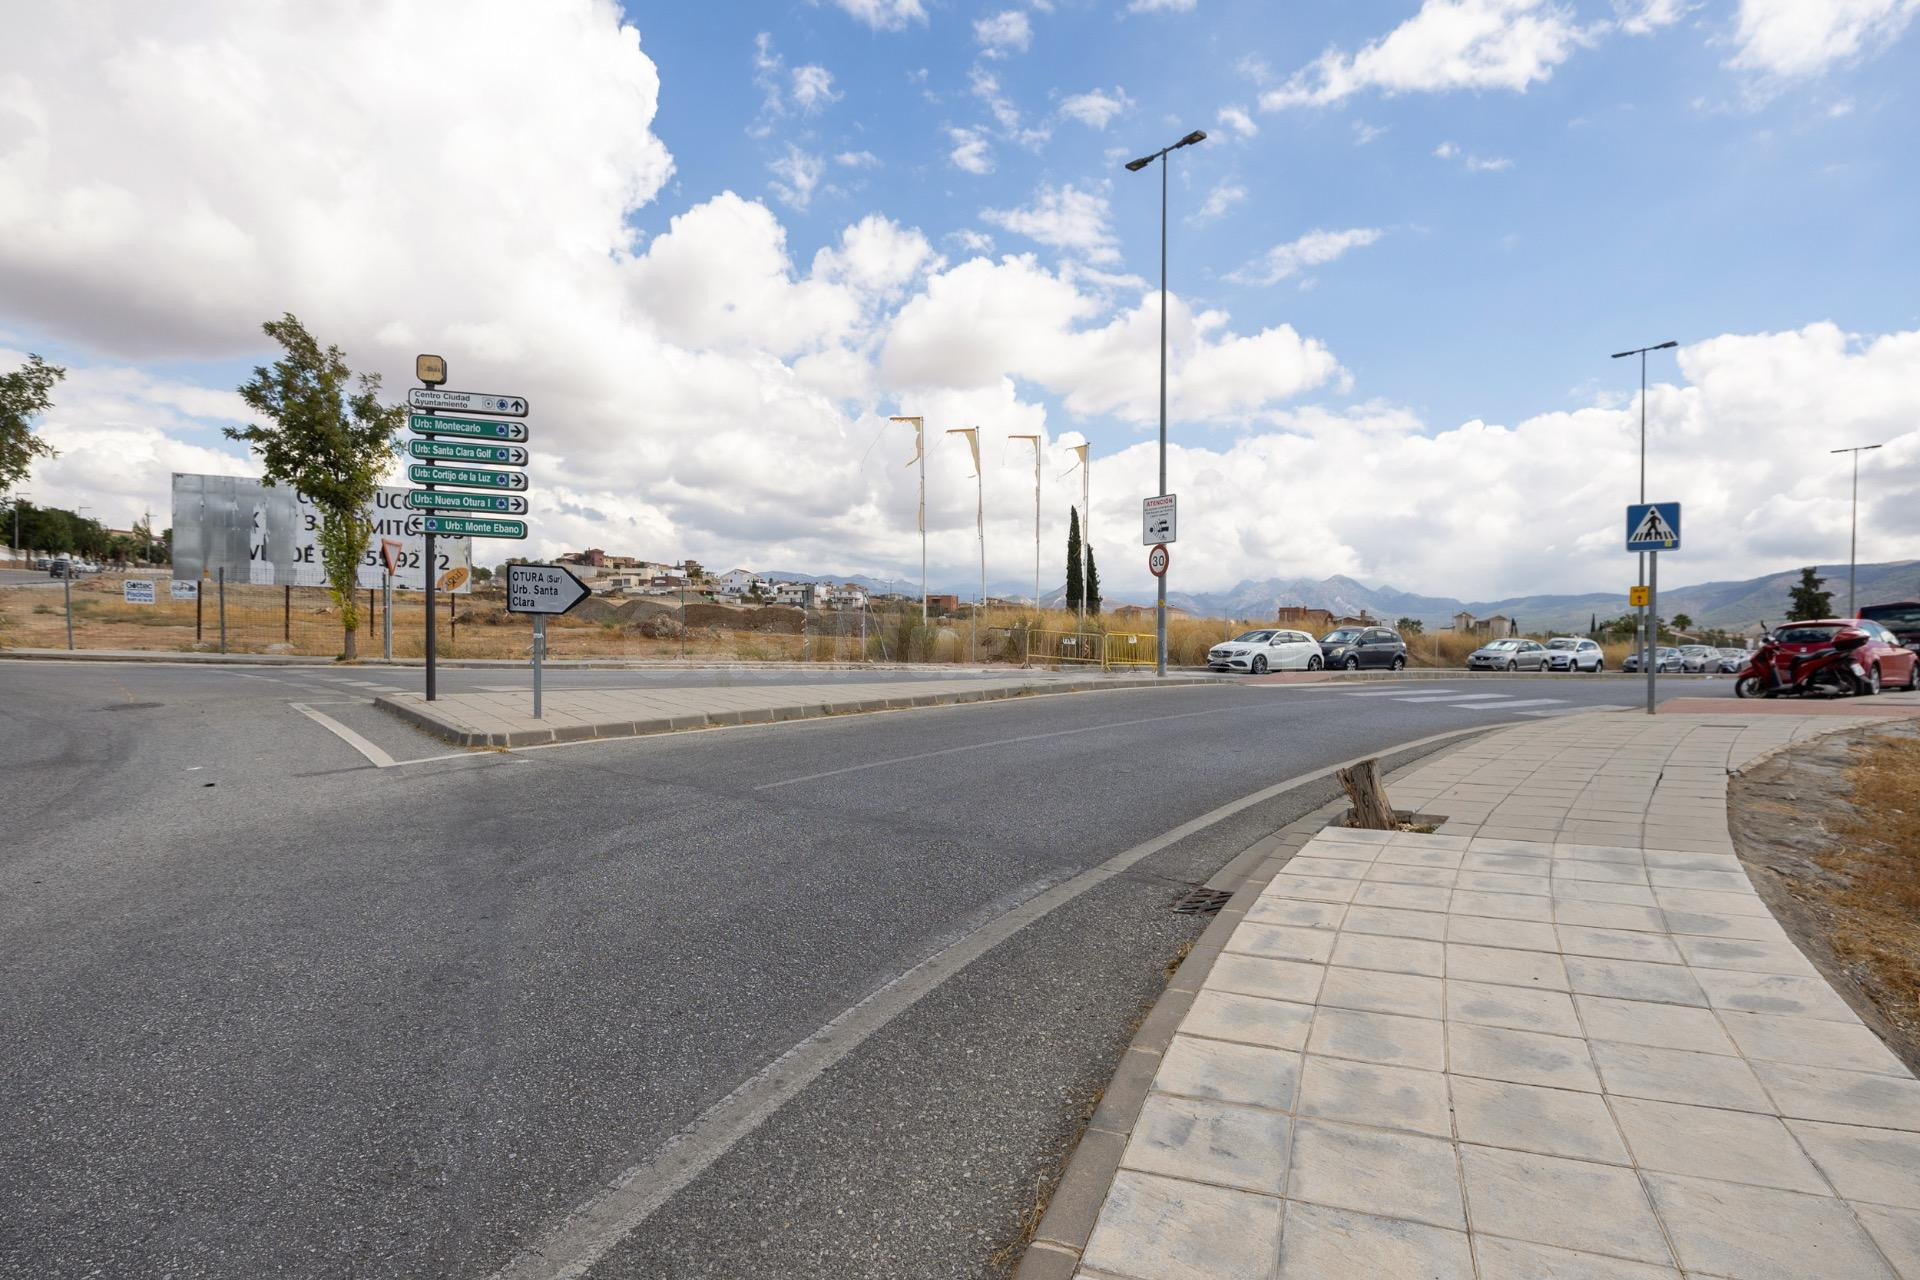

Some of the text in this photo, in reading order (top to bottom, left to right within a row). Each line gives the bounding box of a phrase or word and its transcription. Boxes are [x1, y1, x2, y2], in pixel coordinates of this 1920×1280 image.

[414, 390, 470, 402] Centro Ciudad
[414, 398, 468, 408] Ayuntamiento
[414, 418, 481, 432] Urb: Montecarlo
[414, 444, 492, 458] Urb: Santa Clara Golf
[414, 468, 490, 482] Urb: Cortijo de la Luz
[414, 494, 432, 504] Urb:
[435, 496, 460, 506] Nueva
[462, 497, 486, 506] Otura
[446, 520, 520, 534] Urb: Monte Ebano
[1152, 556, 1165, 567] 30
[512, 571, 562, 584] OTURA (Sur)
[512, 584, 559, 596] Urb. Santa
[512, 597, 535, 606] Clara
